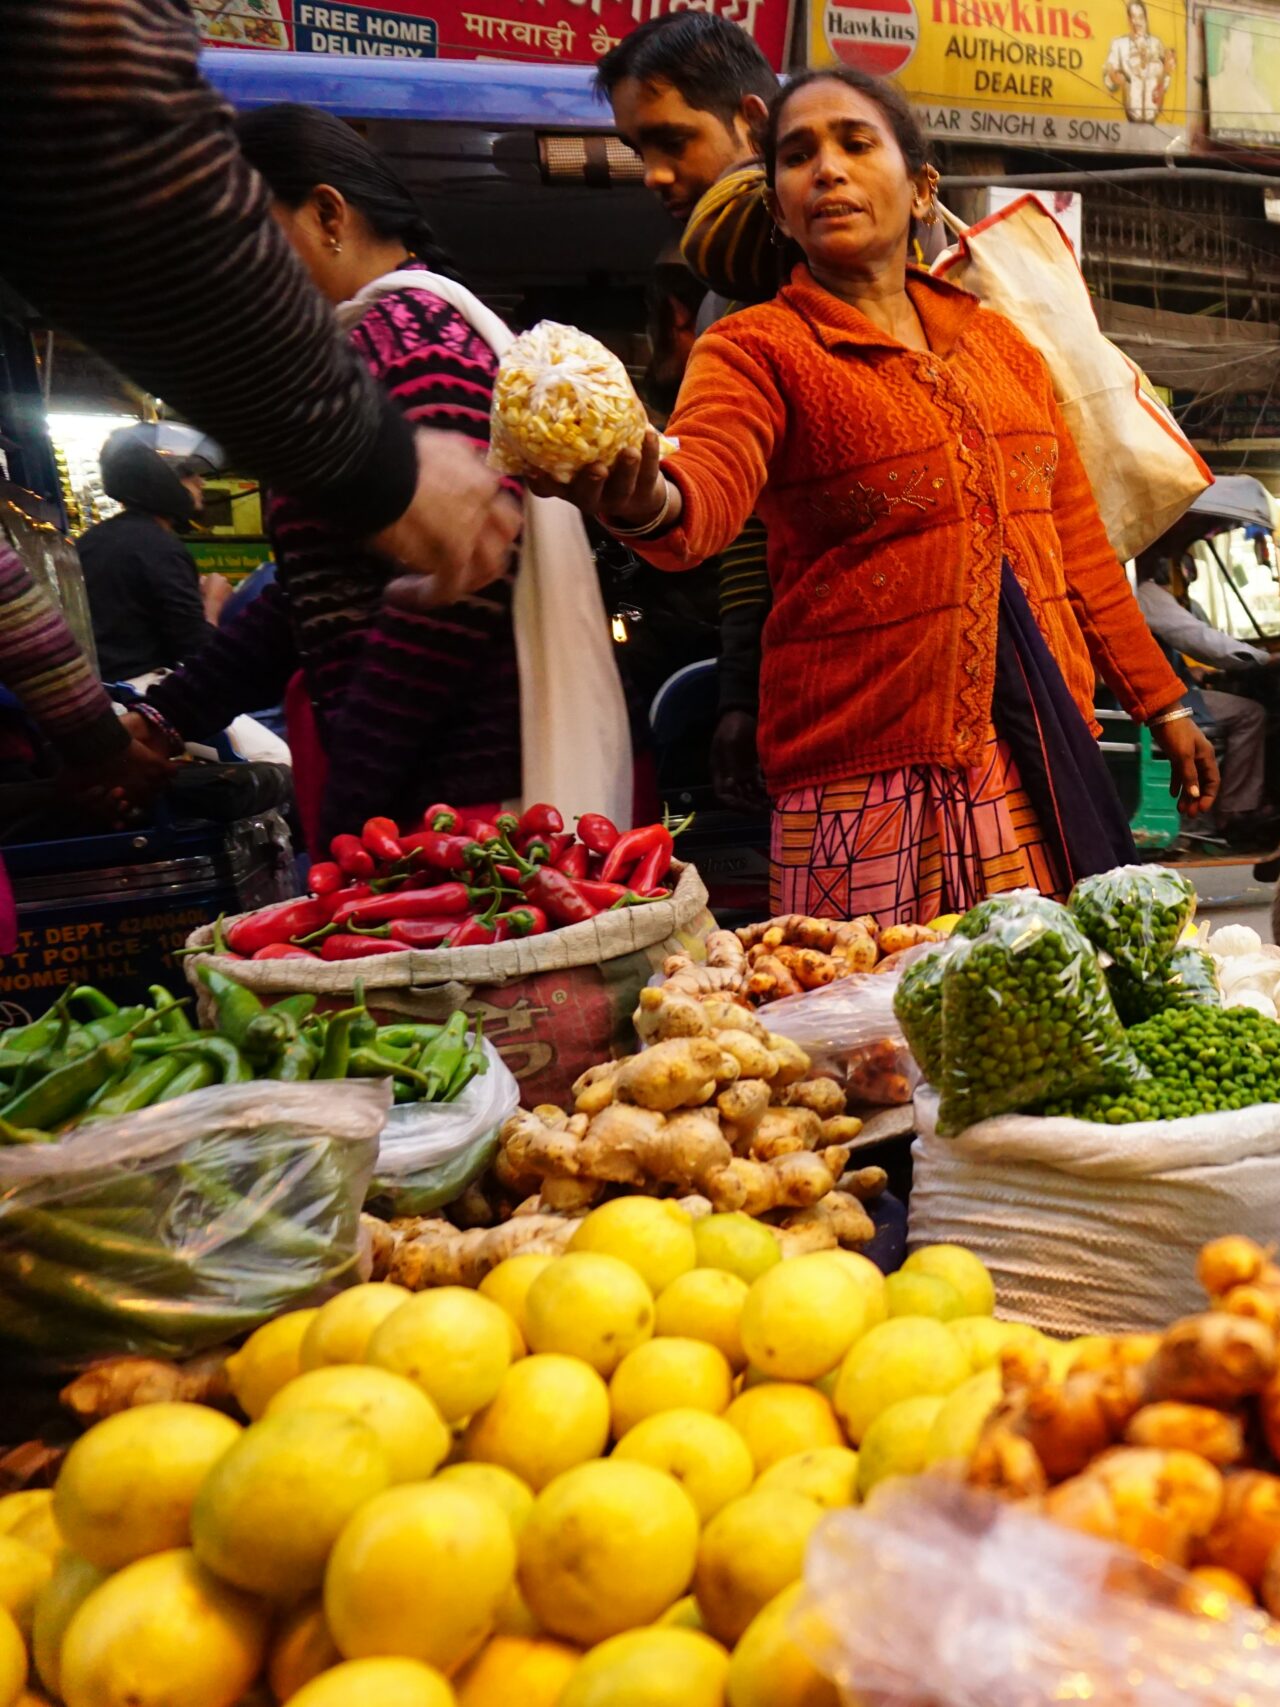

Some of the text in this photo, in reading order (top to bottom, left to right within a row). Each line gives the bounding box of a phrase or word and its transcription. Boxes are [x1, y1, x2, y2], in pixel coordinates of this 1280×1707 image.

[300, 4, 432, 44] FREE HOME
[461, 12, 576, 56] मारवाड़ी
[827, 12, 914, 41] Hawkins
[311, 32, 422, 58] DELIVERY
[945, 35, 1083, 69] AUTHORISED
[974, 70, 1053, 98] DEALER
[970, 111, 1034, 137] SINGH
[1044, 116, 1056, 138] &
[1068, 119, 1121, 142] SONS
